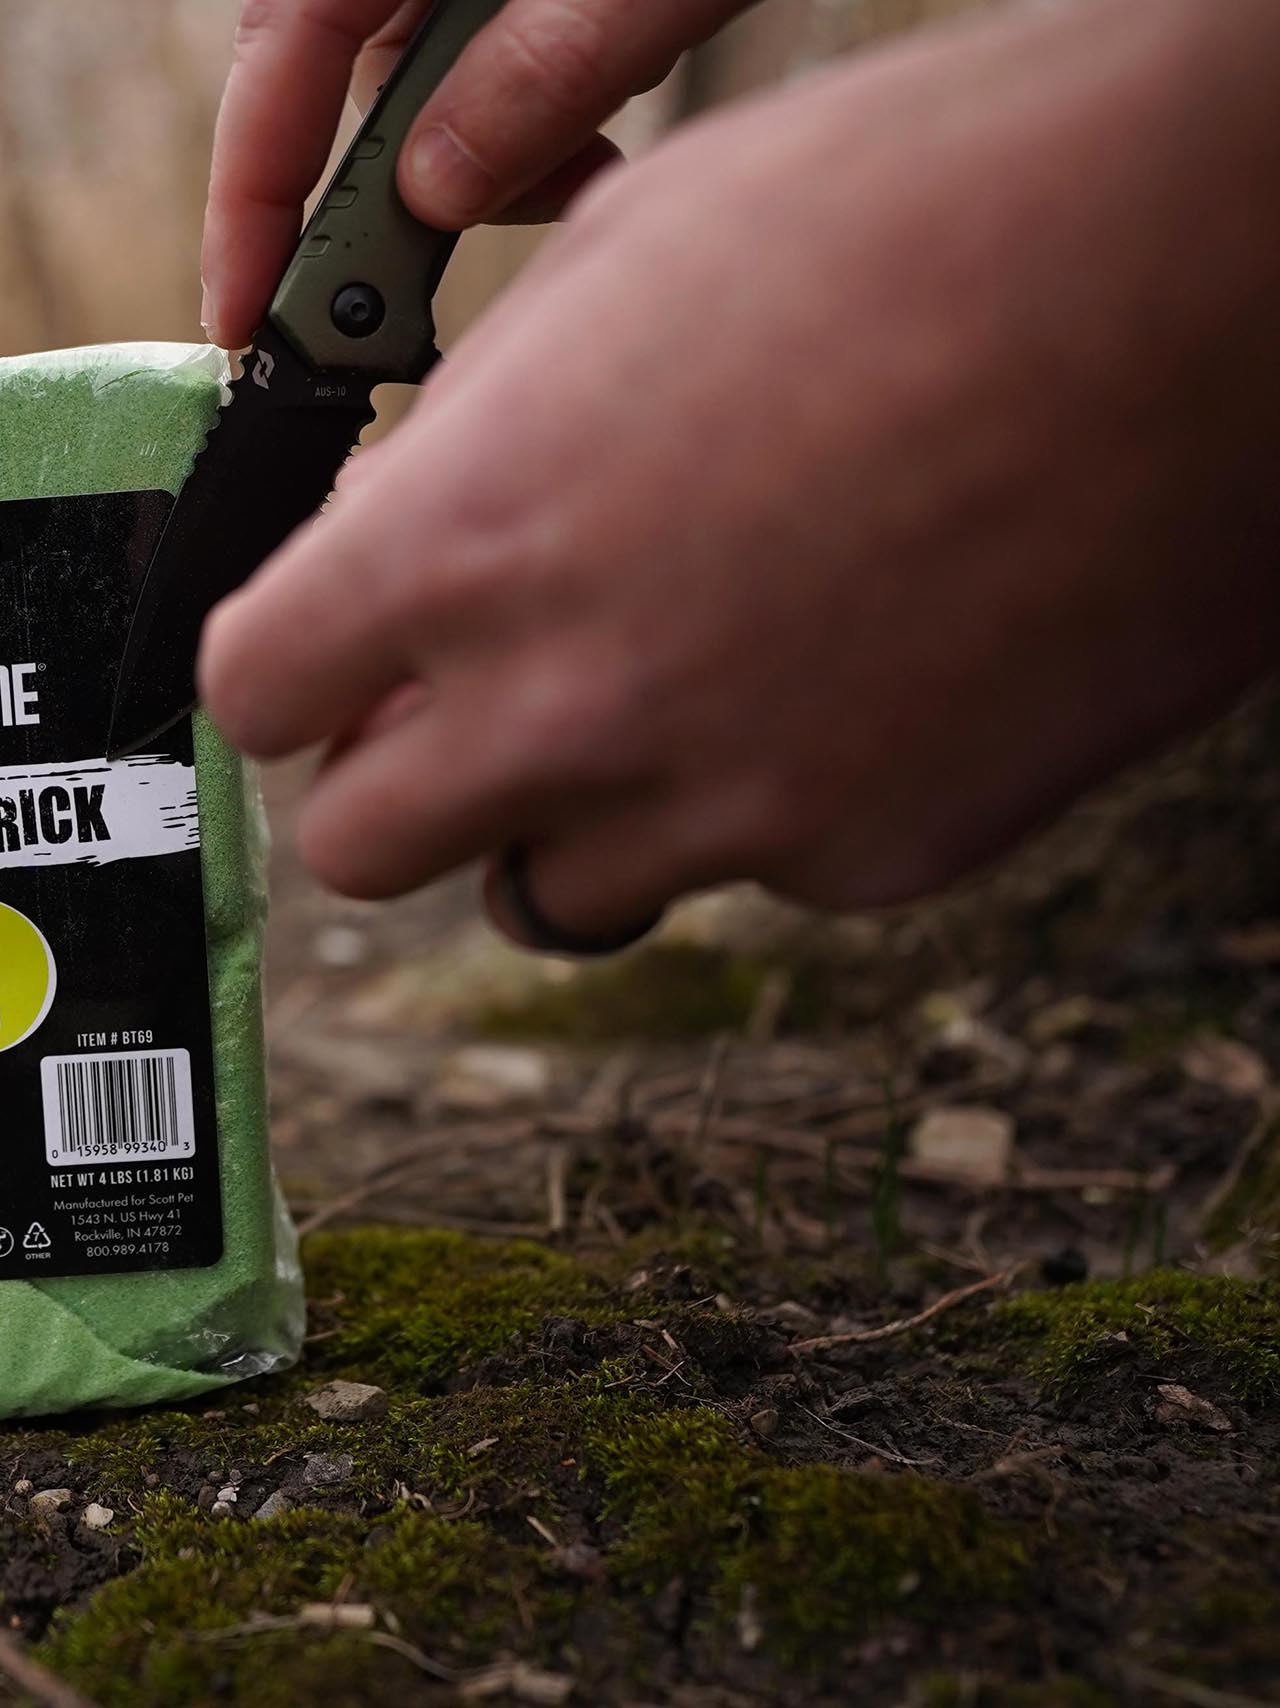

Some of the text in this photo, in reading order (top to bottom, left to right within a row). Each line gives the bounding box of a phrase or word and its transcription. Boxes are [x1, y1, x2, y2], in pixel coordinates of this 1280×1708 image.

[315, 386, 346, 398] AUS-10
[77, 1030, 153, 1047] ITEM # BT69
[51, 1167, 194, 1188] NET WT 4 LBS (1.81 KG)
[53, 1193, 194, 1210] Manufactured for Scott Pet
[72, 1209, 180, 1226] 1543 N. US Hwy 41
[74, 1225, 182, 1242] Rockville, IN 47872
[25, 1252, 51, 1260] OTHER
[87, 1242, 169, 1257] 800.989.4178
